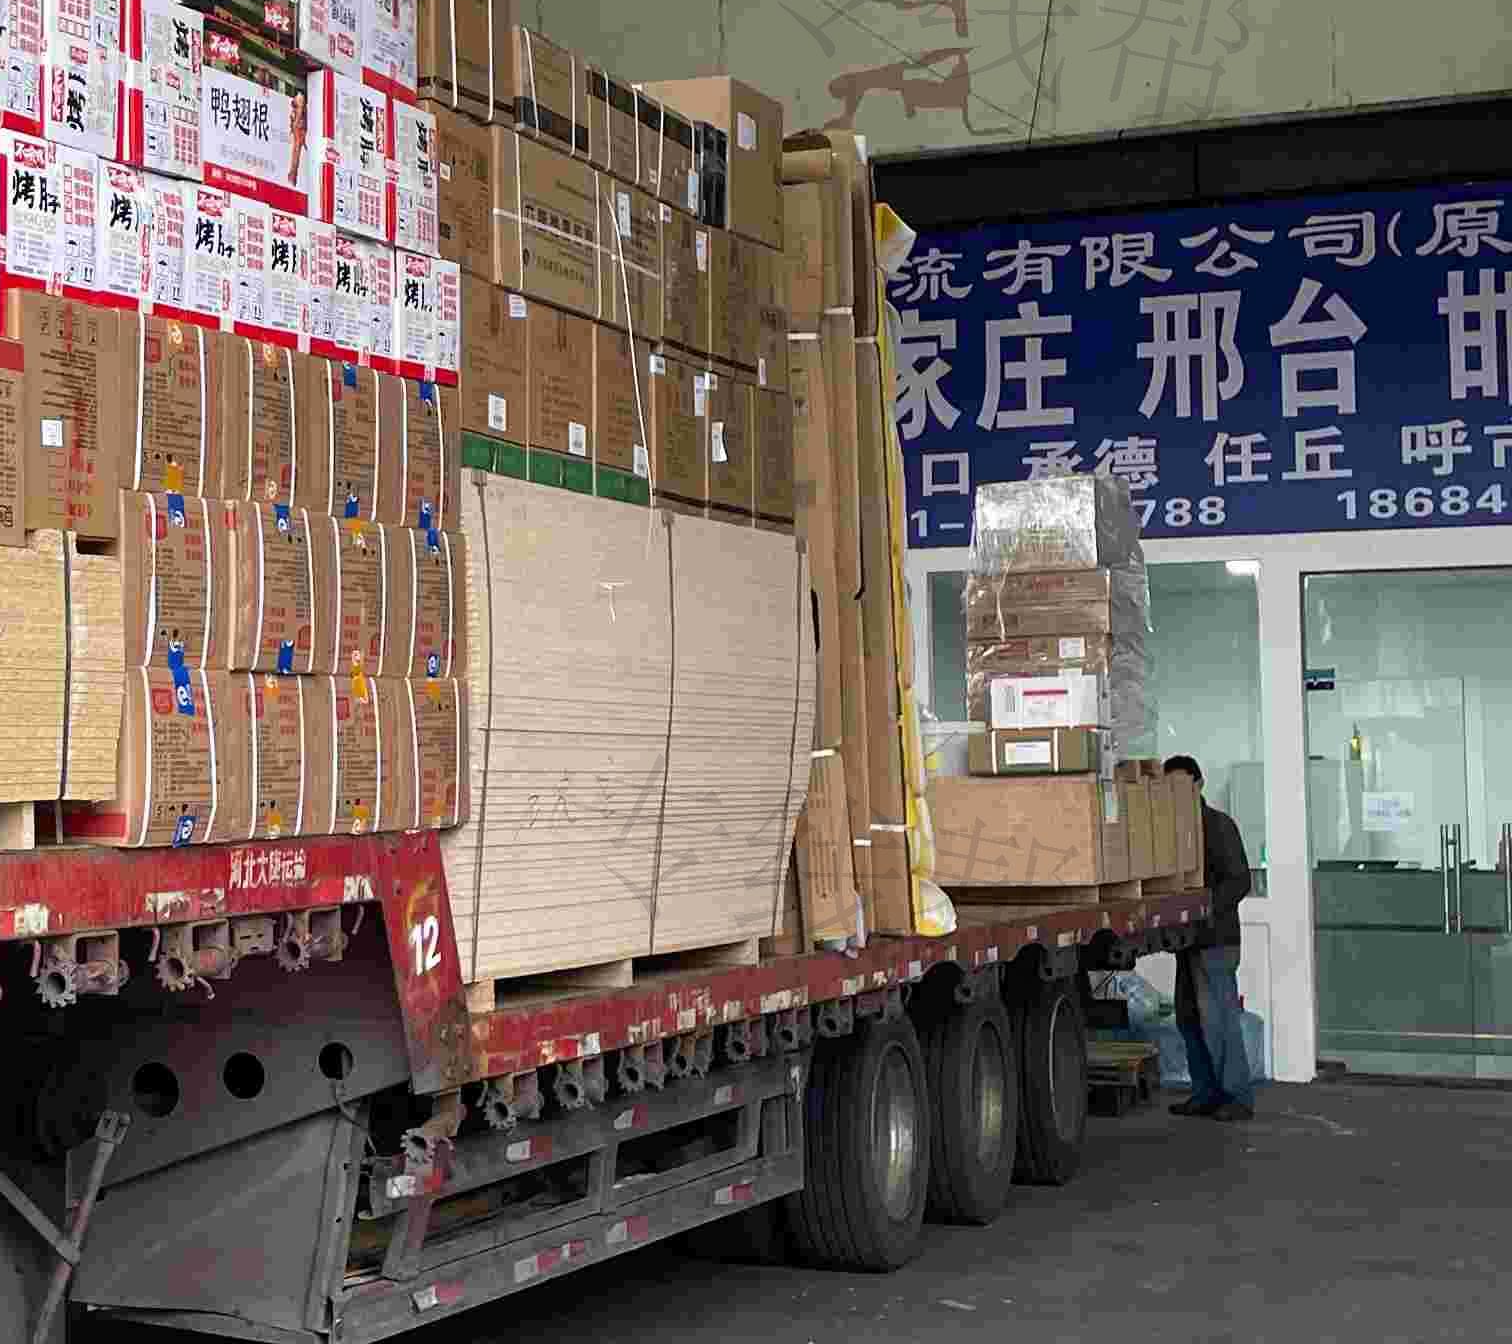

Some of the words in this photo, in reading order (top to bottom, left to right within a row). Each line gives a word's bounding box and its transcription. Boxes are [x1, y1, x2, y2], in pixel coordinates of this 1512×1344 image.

[210, 86, 271, 142] 鸭翅根
[1136, 268, 1368, 422] 邢台
[1204, 424, 1353, 489] 任丘
[409, 914, 440, 976] 12
